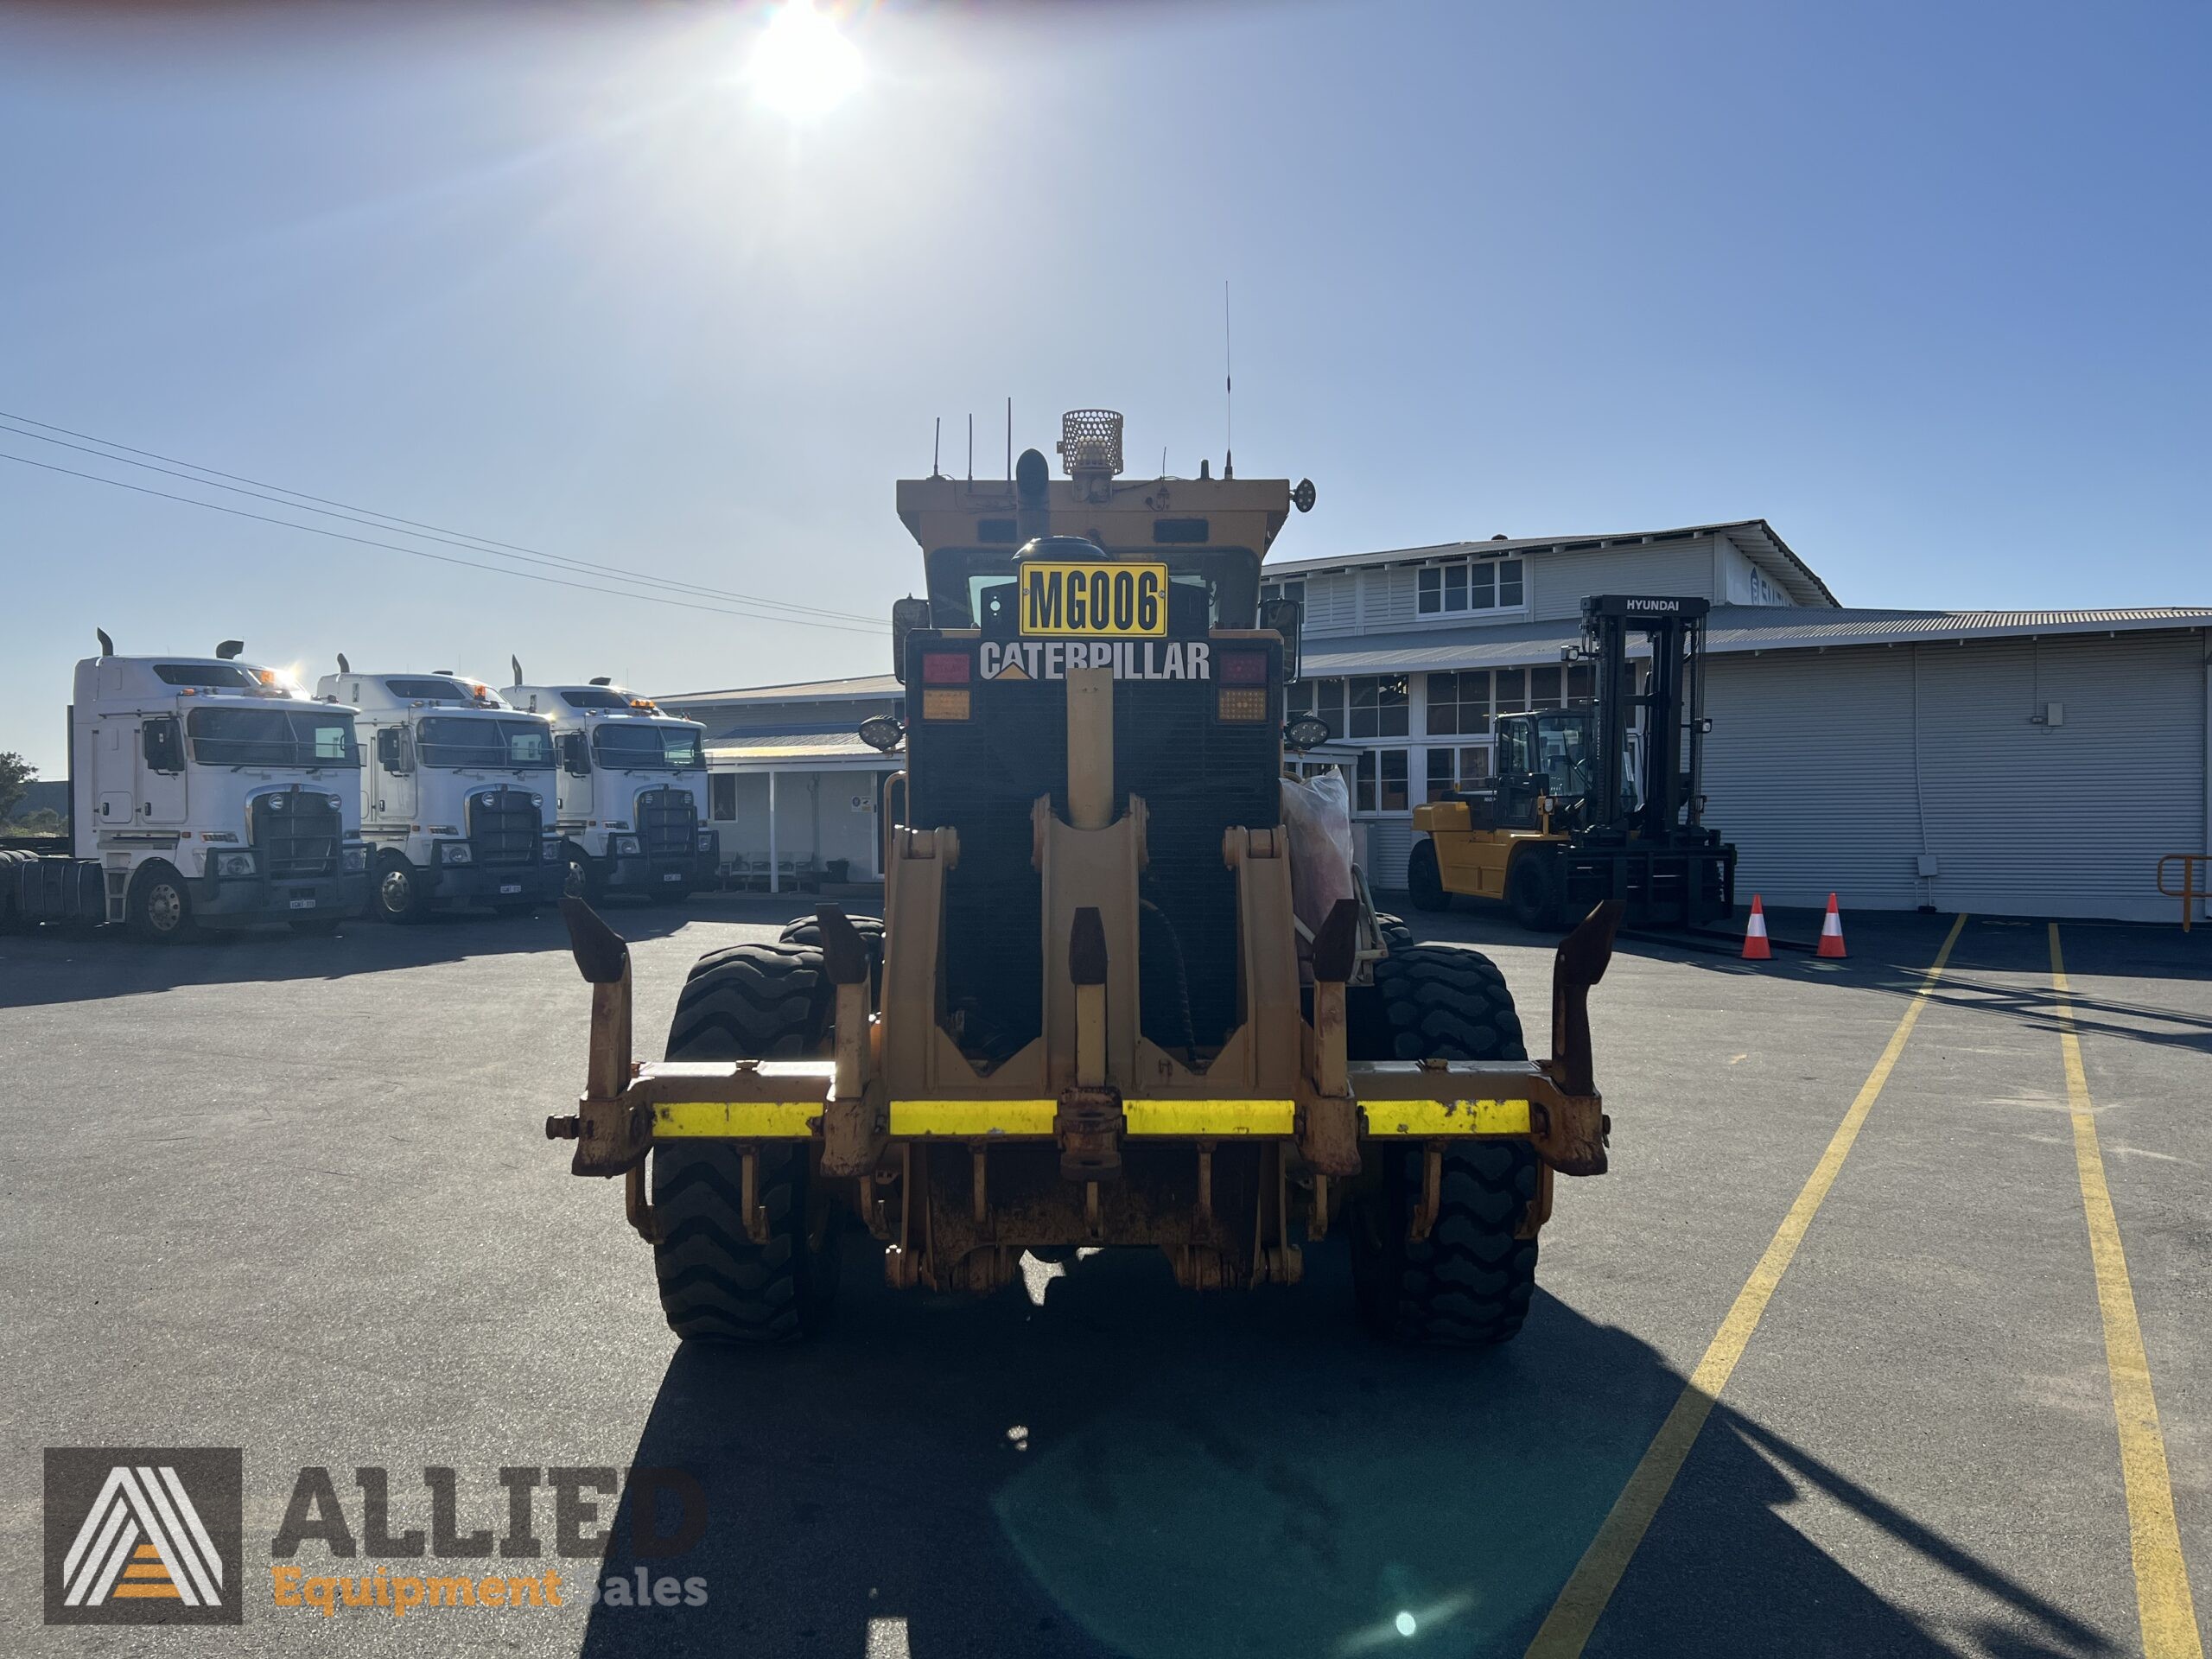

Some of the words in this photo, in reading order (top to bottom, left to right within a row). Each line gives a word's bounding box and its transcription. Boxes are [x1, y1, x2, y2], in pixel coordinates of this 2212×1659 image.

[1029, 569, 1158, 631] MG006
[1626, 599, 1680, 612] HYUNDAI
[979, 642, 1211, 681] CATERPILLAR
